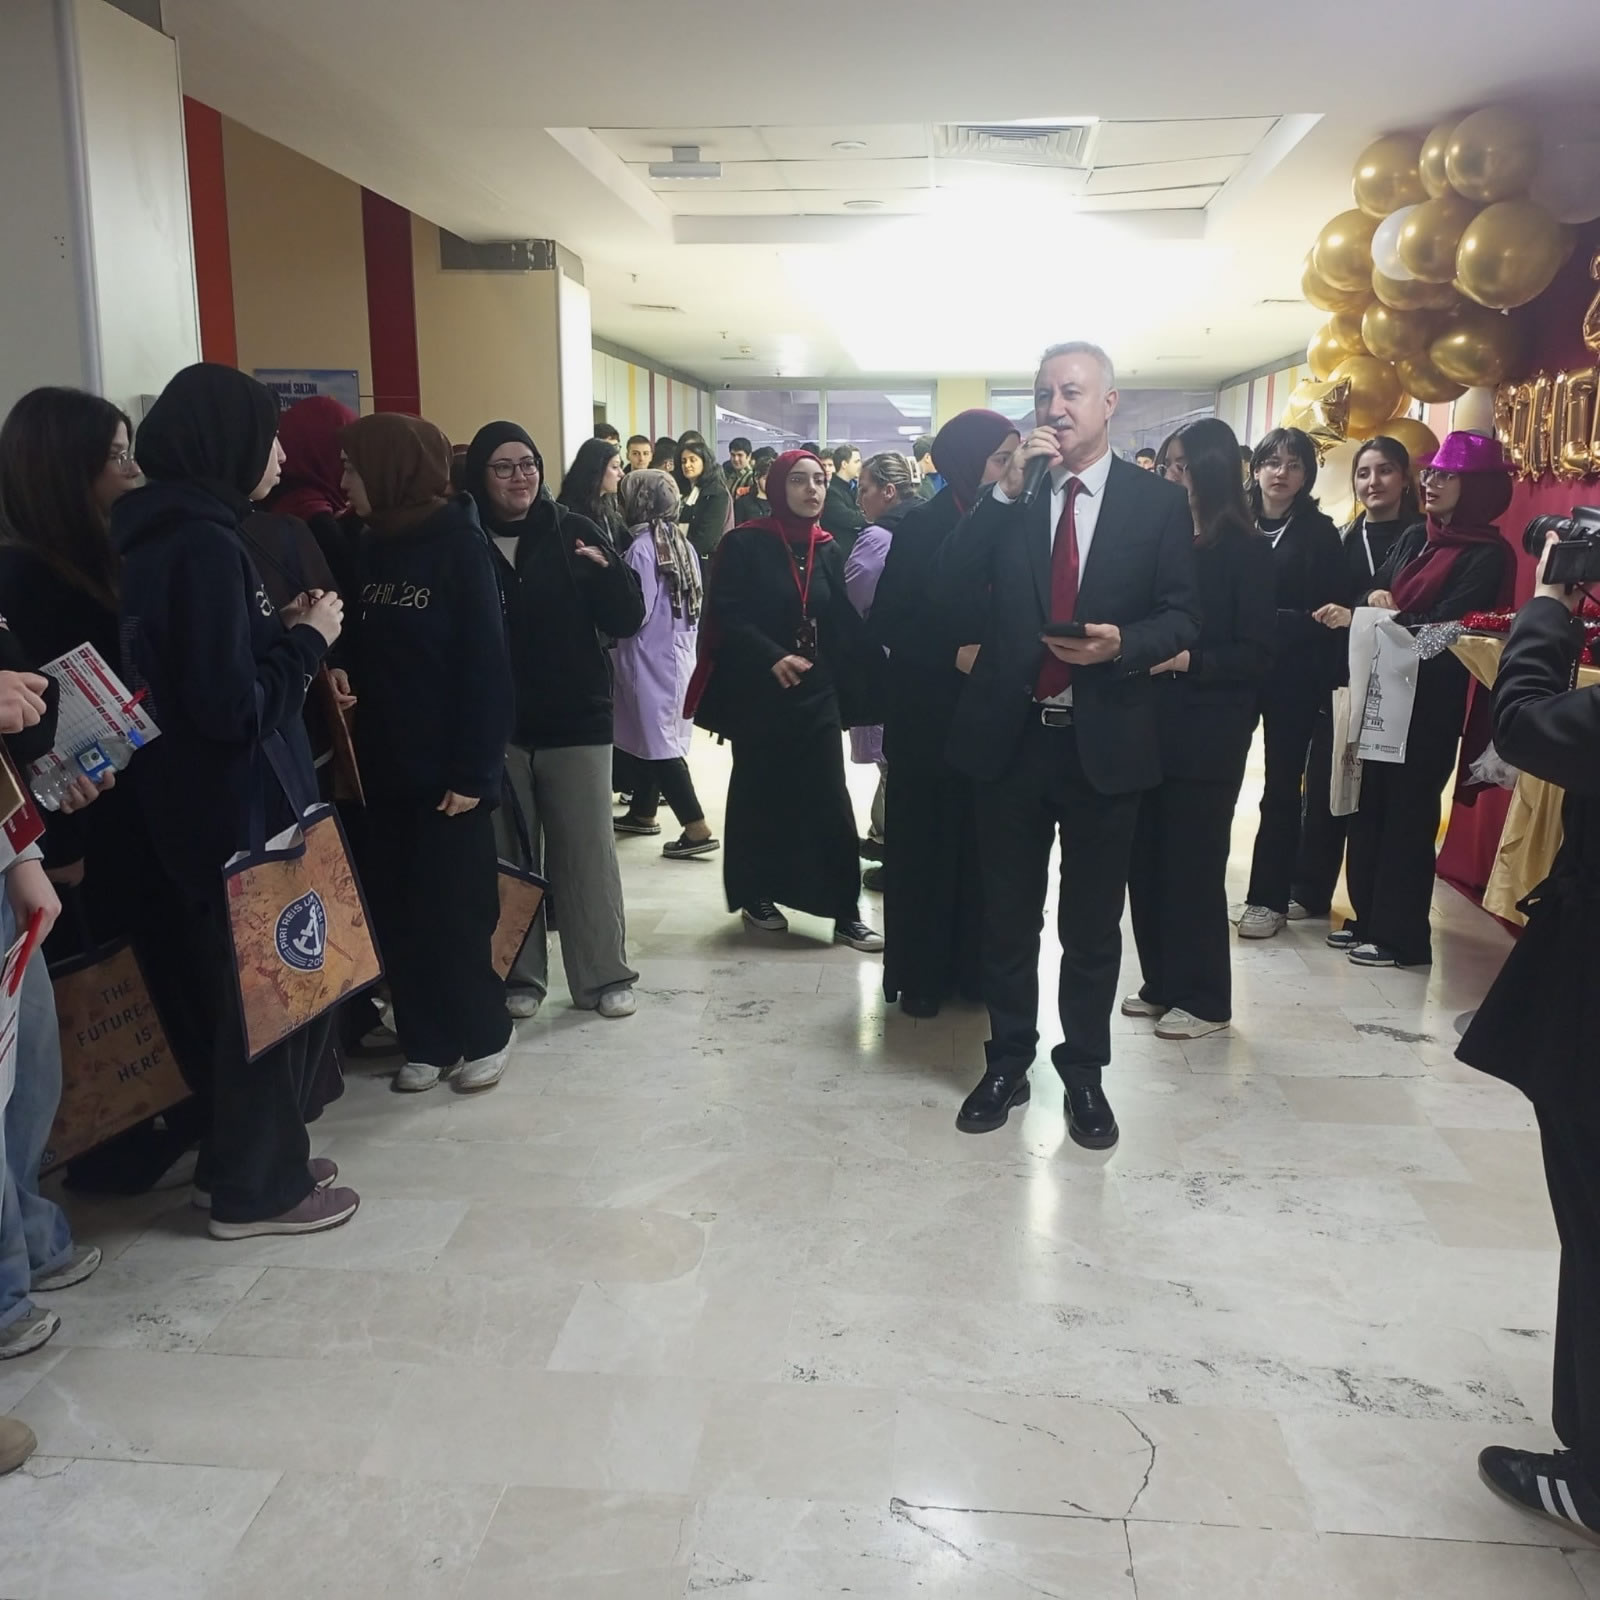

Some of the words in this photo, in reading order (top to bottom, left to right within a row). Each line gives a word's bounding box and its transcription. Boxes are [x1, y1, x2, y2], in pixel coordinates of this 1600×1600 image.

[293, 383, 318, 395] SULTAN
[101, 978, 135, 1005] THE
[76, 1003, 146, 1047] FUTURE
[134, 1027, 152, 1047] IS
[117, 1050, 162, 1084] HERE
